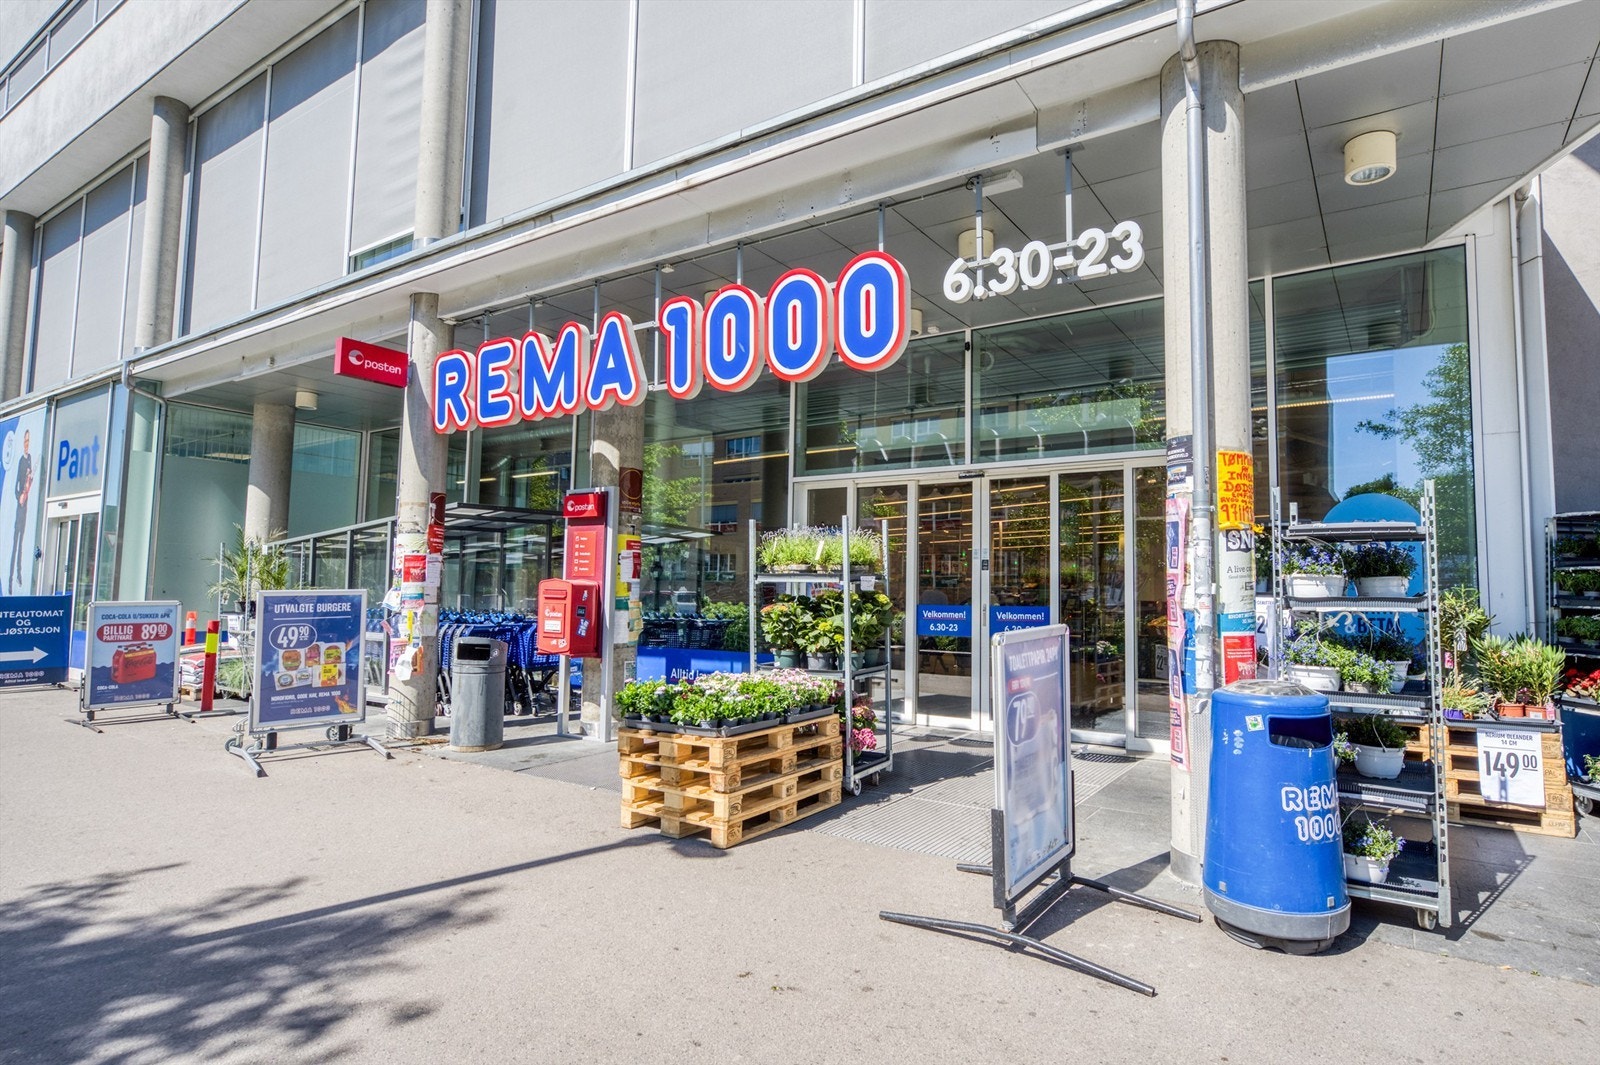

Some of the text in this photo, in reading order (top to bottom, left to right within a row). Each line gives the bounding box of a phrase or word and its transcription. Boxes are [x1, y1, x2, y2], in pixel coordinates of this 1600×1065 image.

[942, 221, 1146, 303] 6.30-23
[433, 251, 911, 434] REMA 1000
[364, 358, 402, 376] posten
[57, 434, 100, 481] Pant
[575, 503, 594, 512] posten
[274, 602, 351, 614] UTVALGTE BURGERE
[922, 610, 966, 620] Velkommen!
[996, 611, 1045, 621] Velkommen!
[103, 625, 134, 635] BILLIG
[929, 623, 958, 632] 6.30-23
[670, 668, 695, 680] Alltid
[1506, 733, 1533, 741] OLEANDER
[1483, 750, 1538, 779] 149 00
[1281, 783, 1339, 812] REM
